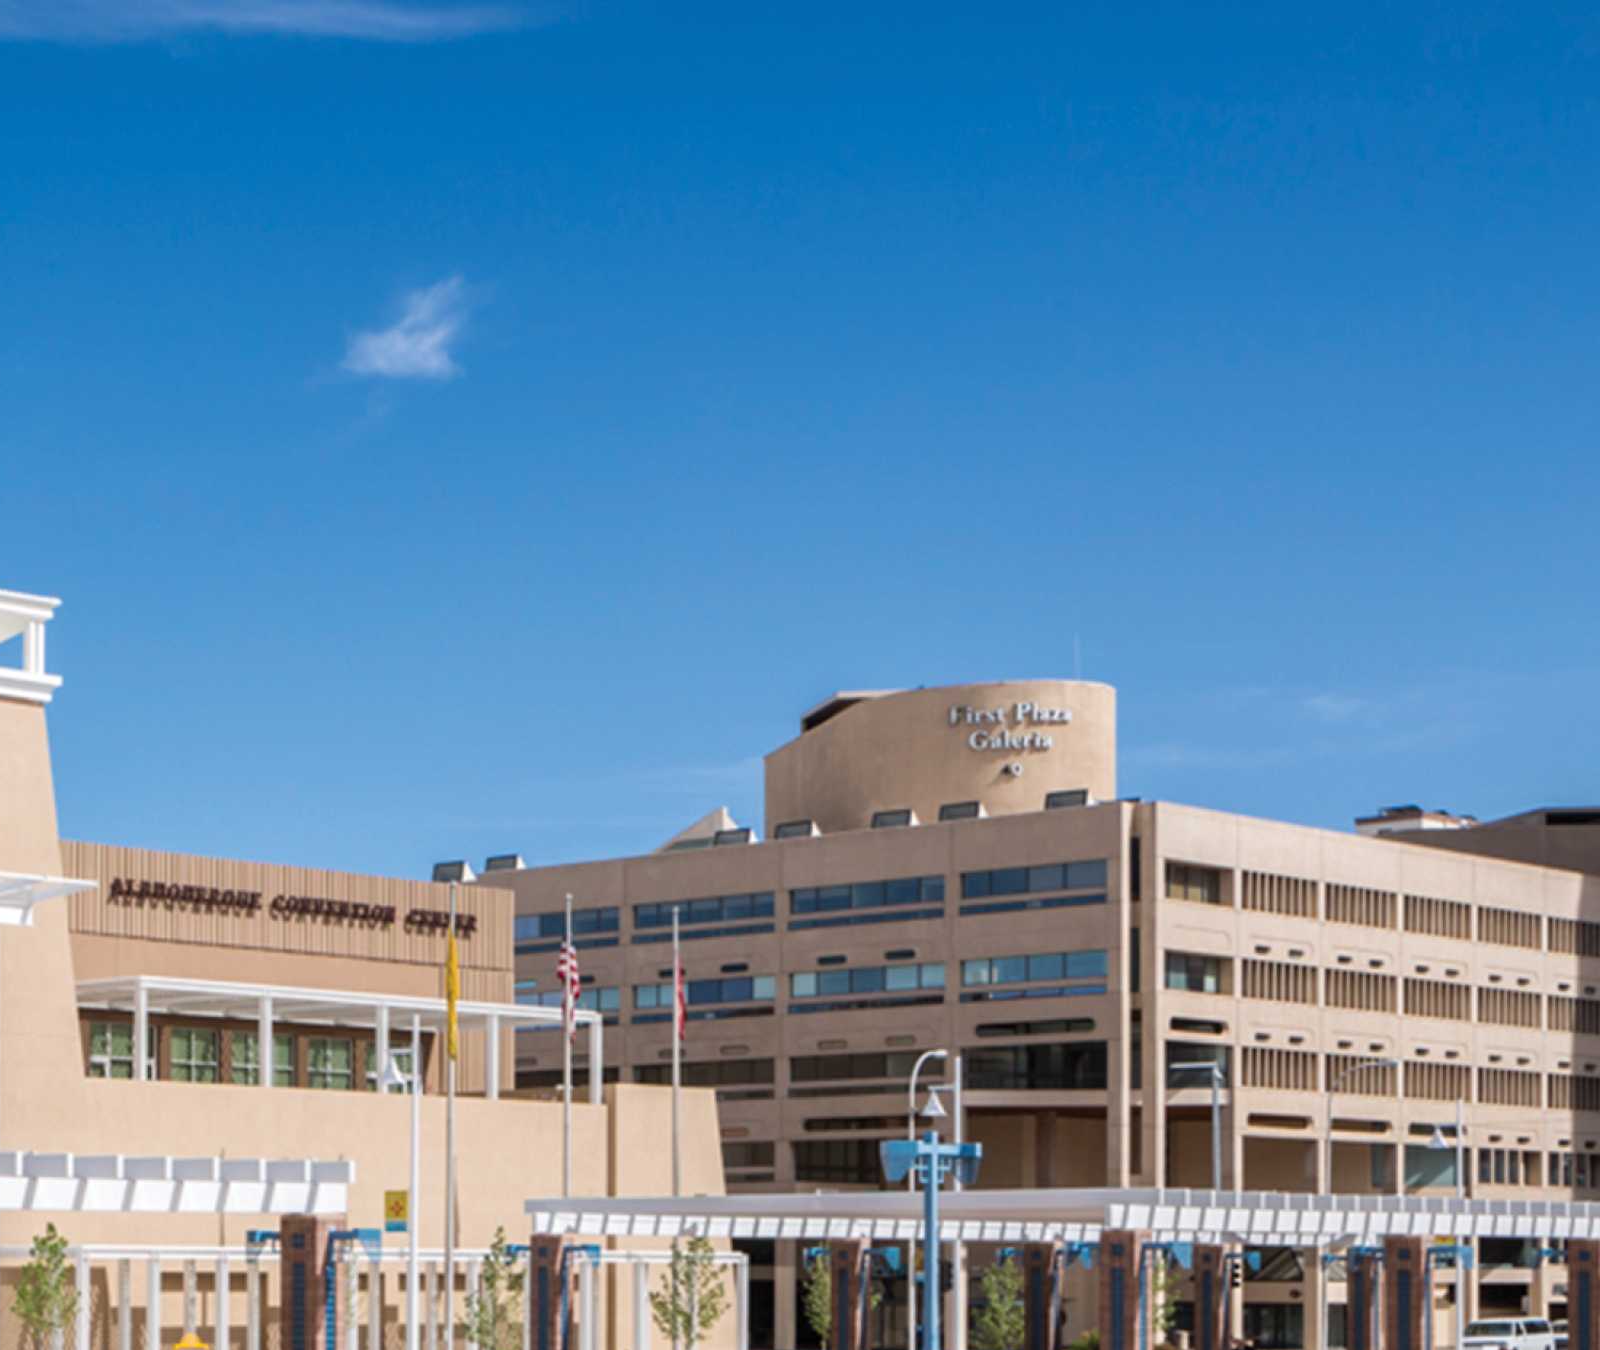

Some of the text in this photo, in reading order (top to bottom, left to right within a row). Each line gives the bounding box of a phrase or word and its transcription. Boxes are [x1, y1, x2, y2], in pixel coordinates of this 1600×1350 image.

[949, 702, 1073, 724] First Plaza
[969, 730, 1054, 751] Galeria
[110, 877, 263, 910] ALBUQUERQUE
[271, 895, 395, 924] CONVENTION
